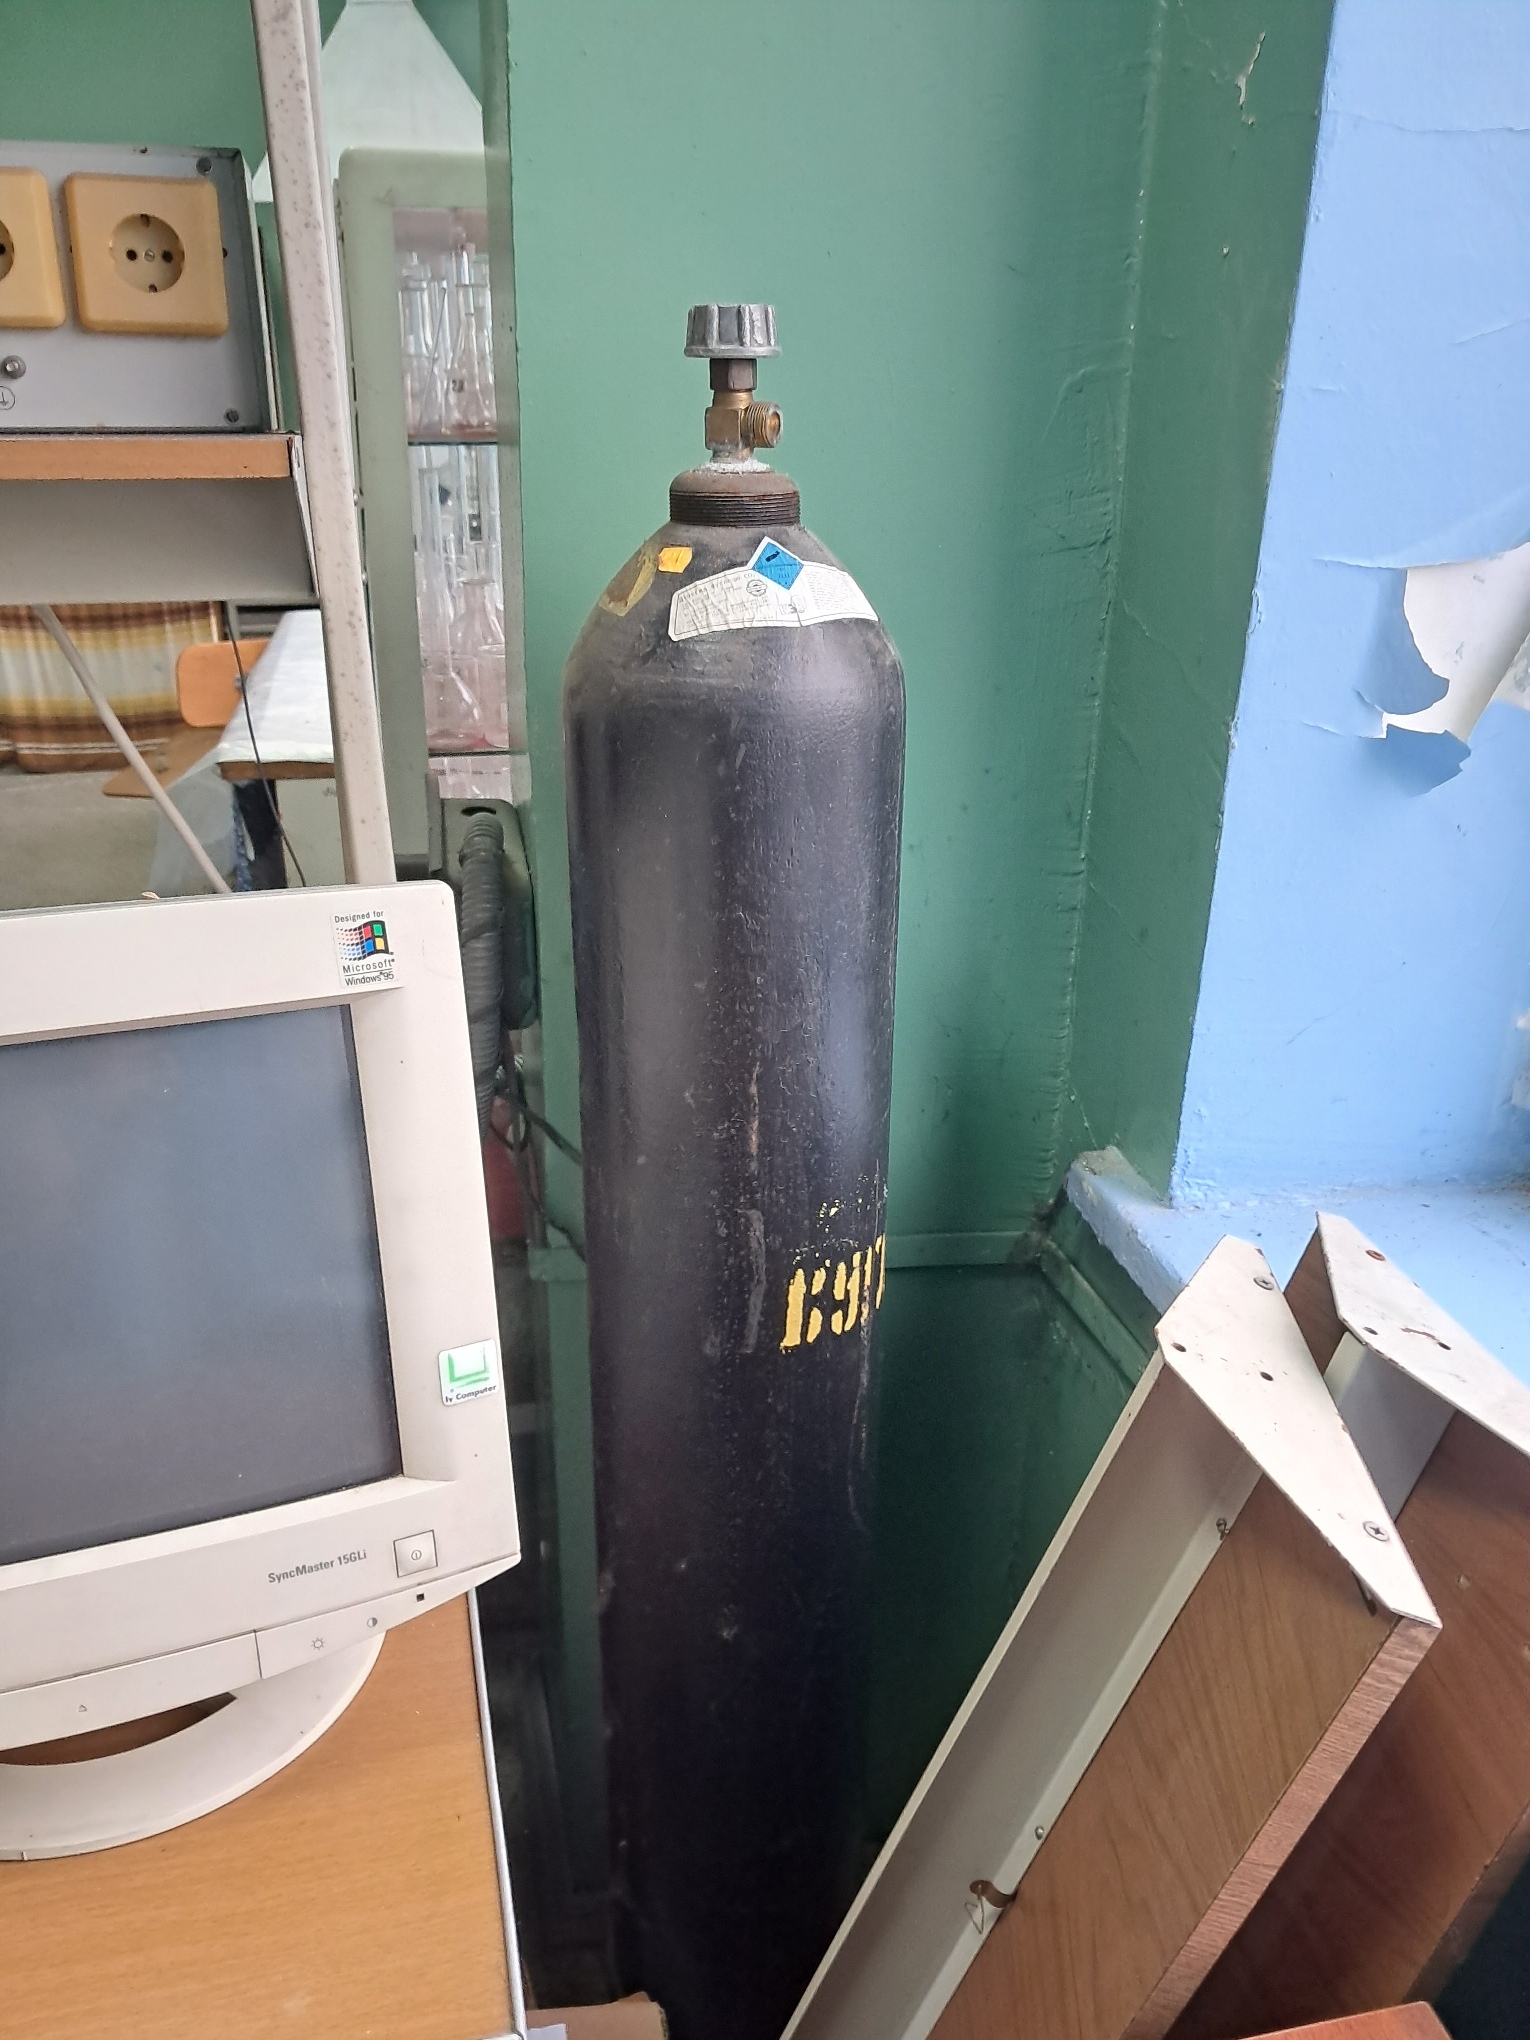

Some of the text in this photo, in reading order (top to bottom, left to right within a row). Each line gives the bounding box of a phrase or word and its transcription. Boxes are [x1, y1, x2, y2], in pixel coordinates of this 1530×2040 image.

[334, 910, 384, 923] Designed for
[342, 959, 393, 974] Microsoft
[345, 972, 381, 987] Windows
[455, 1384, 497, 1400] Computer
[267, 1549, 367, 1584] SyncMaster 15GLi
